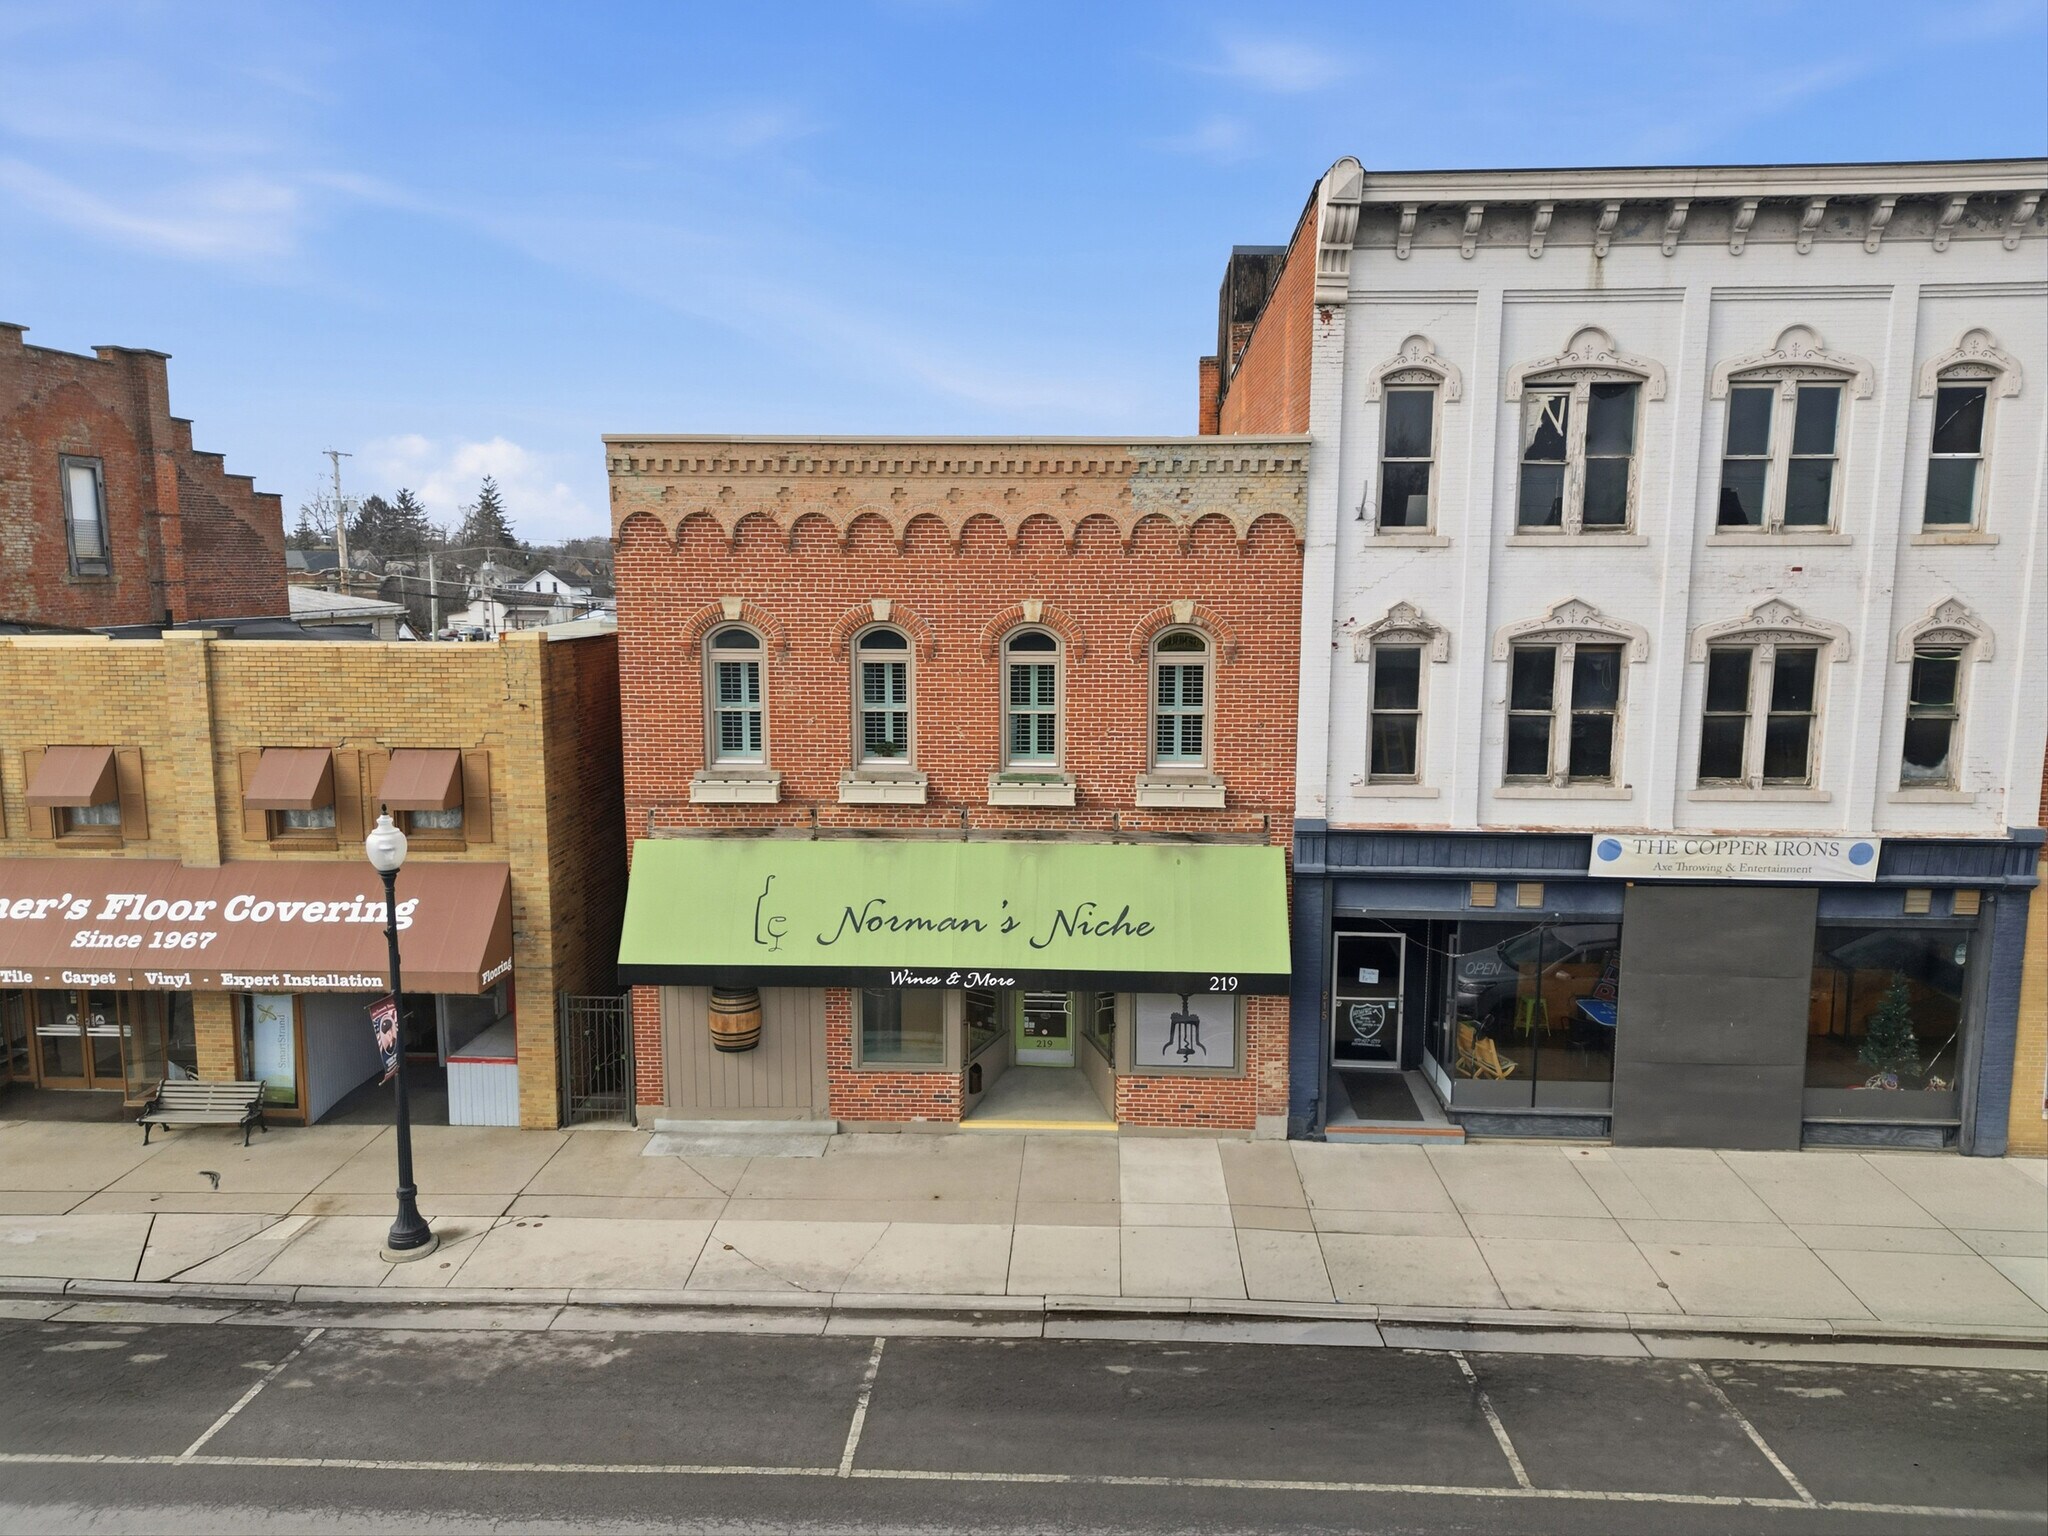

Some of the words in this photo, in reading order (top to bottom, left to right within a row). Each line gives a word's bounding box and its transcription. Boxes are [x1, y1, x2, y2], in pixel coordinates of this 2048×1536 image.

[1633, 839, 1679, 856] THE
[1684, 840, 1768, 857] COPPER
[1774, 841, 1840, 859] IRONS
[1652, 862, 1673, 872] Axe
[1675, 861, 1722, 875] Throwing
[1726, 863, 1736, 873] &
[1739, 863, 1812, 875] Entertainment
[96, 893, 217, 922] Floor
[224, 894, 420, 931] Covering
[817, 898, 1021, 946] Norman's
[1029, 899, 1156, 949] Niche
[70, 929, 143, 950] Since
[148, 931, 217, 951] 1967
[481, 956, 513, 986] Flooring
[1465, 961, 1503, 976] OPEN
[0, 969, 33, 983] Tile
[61, 970, 116, 987] Carpet
[144, 971, 192, 988] Vinyl
[220, 973, 280, 990] Expert
[283, 973, 384, 988] Installation
[890, 969, 941, 987] Wines
[946, 970, 960, 986] &
[963, 971, 1016, 989] More
[1209, 975, 1239, 992] 219
[277, 1014, 287, 1069] SmartStrand
[1036, 1039, 1053, 1049] 219
